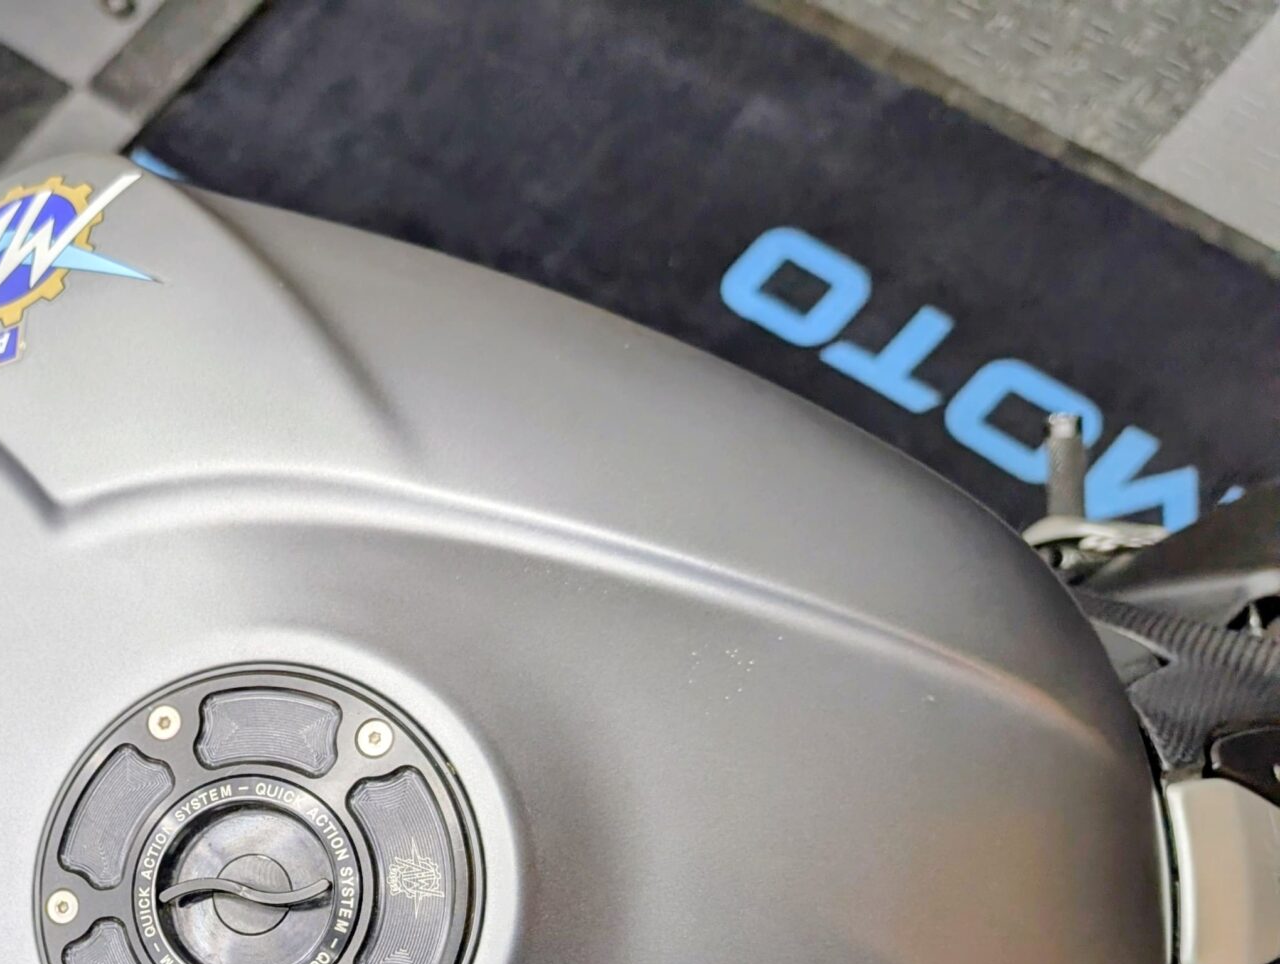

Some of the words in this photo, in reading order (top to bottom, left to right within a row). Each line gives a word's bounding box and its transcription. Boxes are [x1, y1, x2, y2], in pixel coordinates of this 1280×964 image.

[720, 226, 1246, 534] MOTO
[174, 784, 233, 823] SYSTEM
[140, 824, 173, 880] ACTION
[254, 782, 305, 809] QUICK
[306, 801, 350, 862] ACTION
[334, 866, 356, 934] SYSTEM
[138, 886, 156, 938] QUICK
